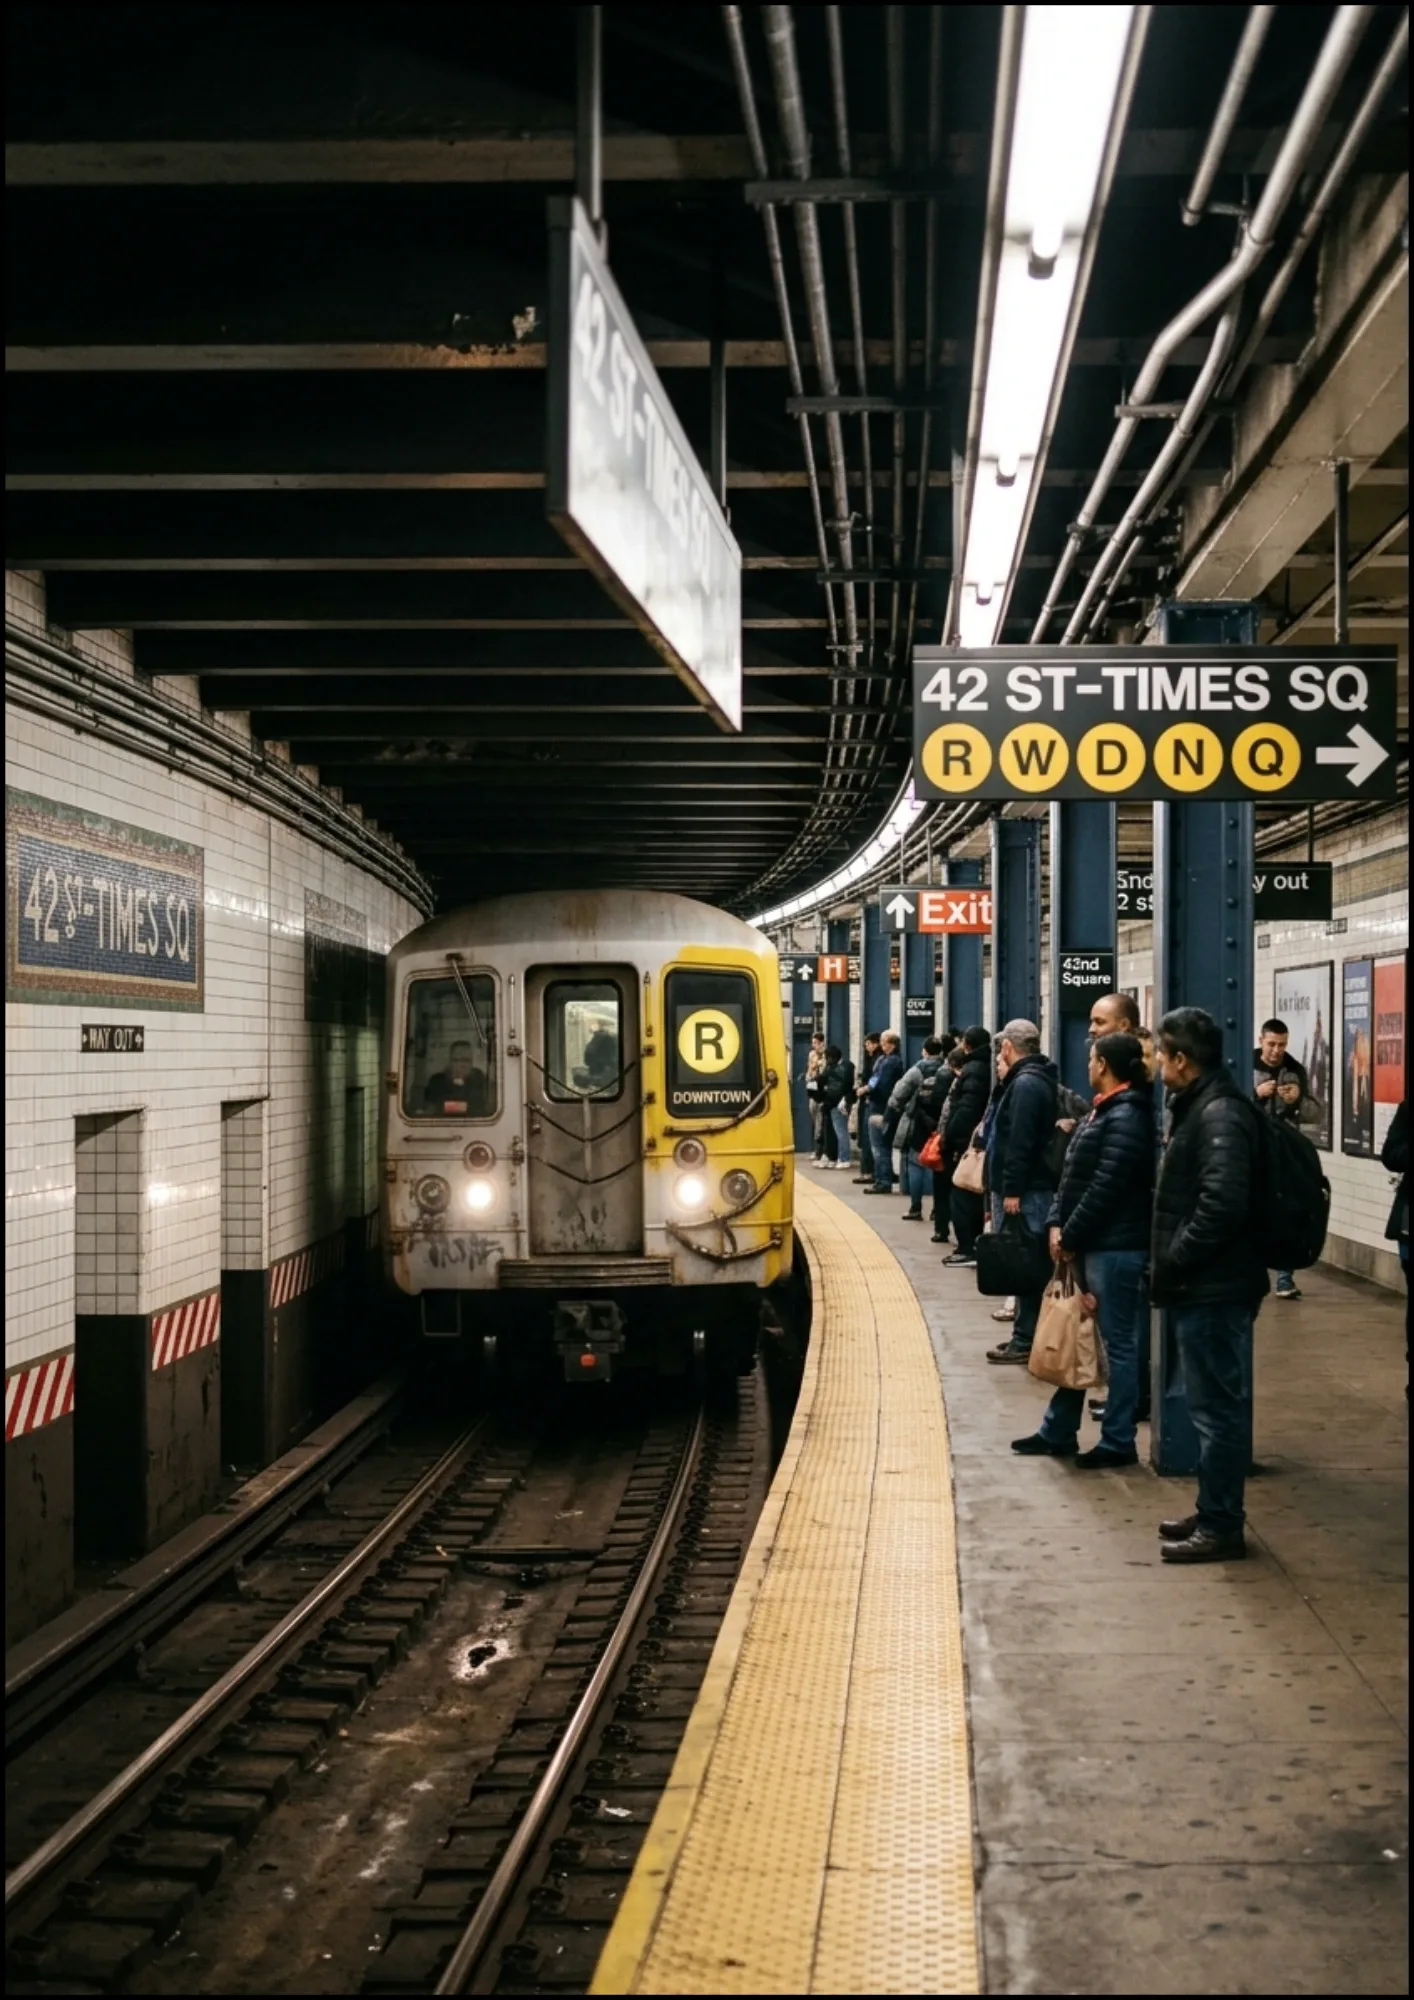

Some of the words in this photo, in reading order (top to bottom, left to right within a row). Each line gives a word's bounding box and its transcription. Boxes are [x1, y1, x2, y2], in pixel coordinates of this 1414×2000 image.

[920, 666, 989, 712] 42
[1005, 665, 1271, 712] ST-TIMES
[1288, 665, 1369, 712] SQ
[942, 739, 973, 776] R
[1011, 740, 1057, 776] W
[1095, 739, 1128, 776] D
[1172, 739, 1204, 776] N
[1248, 737, 1284, 776] Q
[1273, 872, 1310, 891] out
[922, 891, 992, 925] Exit
[165, 894, 190, 962] SQ
[823, 957, 842, 980] H
[1062, 971, 1112, 987] Square
[694, 1021, 725, 1061] R
[672, 1089, 752, 1105] DOWNTOWN
